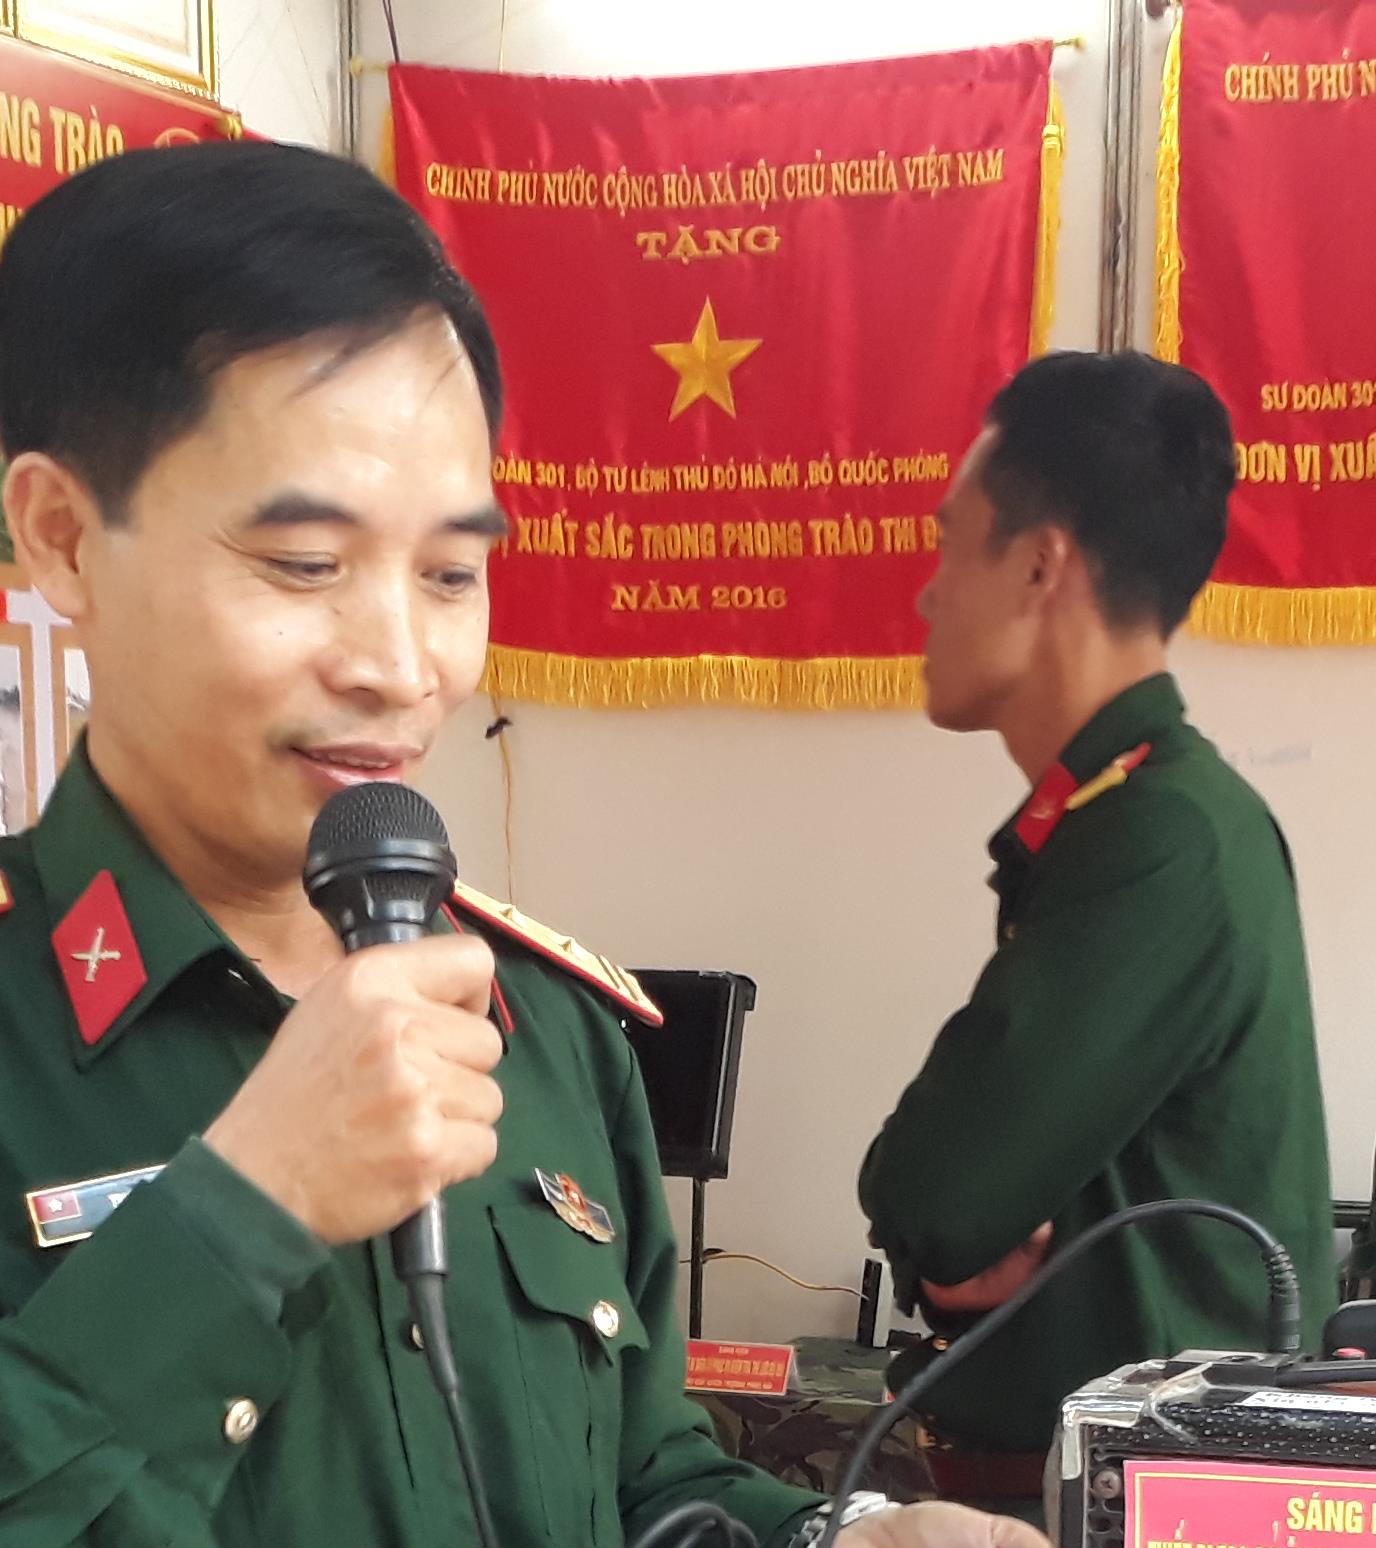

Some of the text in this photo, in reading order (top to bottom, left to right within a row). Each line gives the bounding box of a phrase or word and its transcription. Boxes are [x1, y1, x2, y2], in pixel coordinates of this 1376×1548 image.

[1224, 51, 1300, 103] CHÍNH
[1305, 47, 1354, 101] PHỦ
[543, 164, 597, 207] NƯỚC
[603, 165, 656, 218] CỘNG
[663, 164, 706, 207] HÒA
[741, 159, 776, 212] HỘI
[782, 149, 825, 200] CHỦ
[902, 145, 951, 198] VIỆT
[957, 149, 1004, 186] NAM
[636, 224, 781, 265] TẶNG
[492, 451, 532, 485] OÀN
[838, 449, 890, 488] QUỐC
[1294, 443, 1321, 492] VỊ
[517, 508, 578, 557] XUẤT
[585, 511, 634, 560] SẮC
[640, 522, 716, 560] TRONG
[722, 519, 803, 558] PHONG
[808, 512, 874, 556] TRÀO
[879, 516, 917, 554] THI
[611, 579, 788, 612] NĂM 2016
[1286, 1491, 1363, 1534] SÁNG
